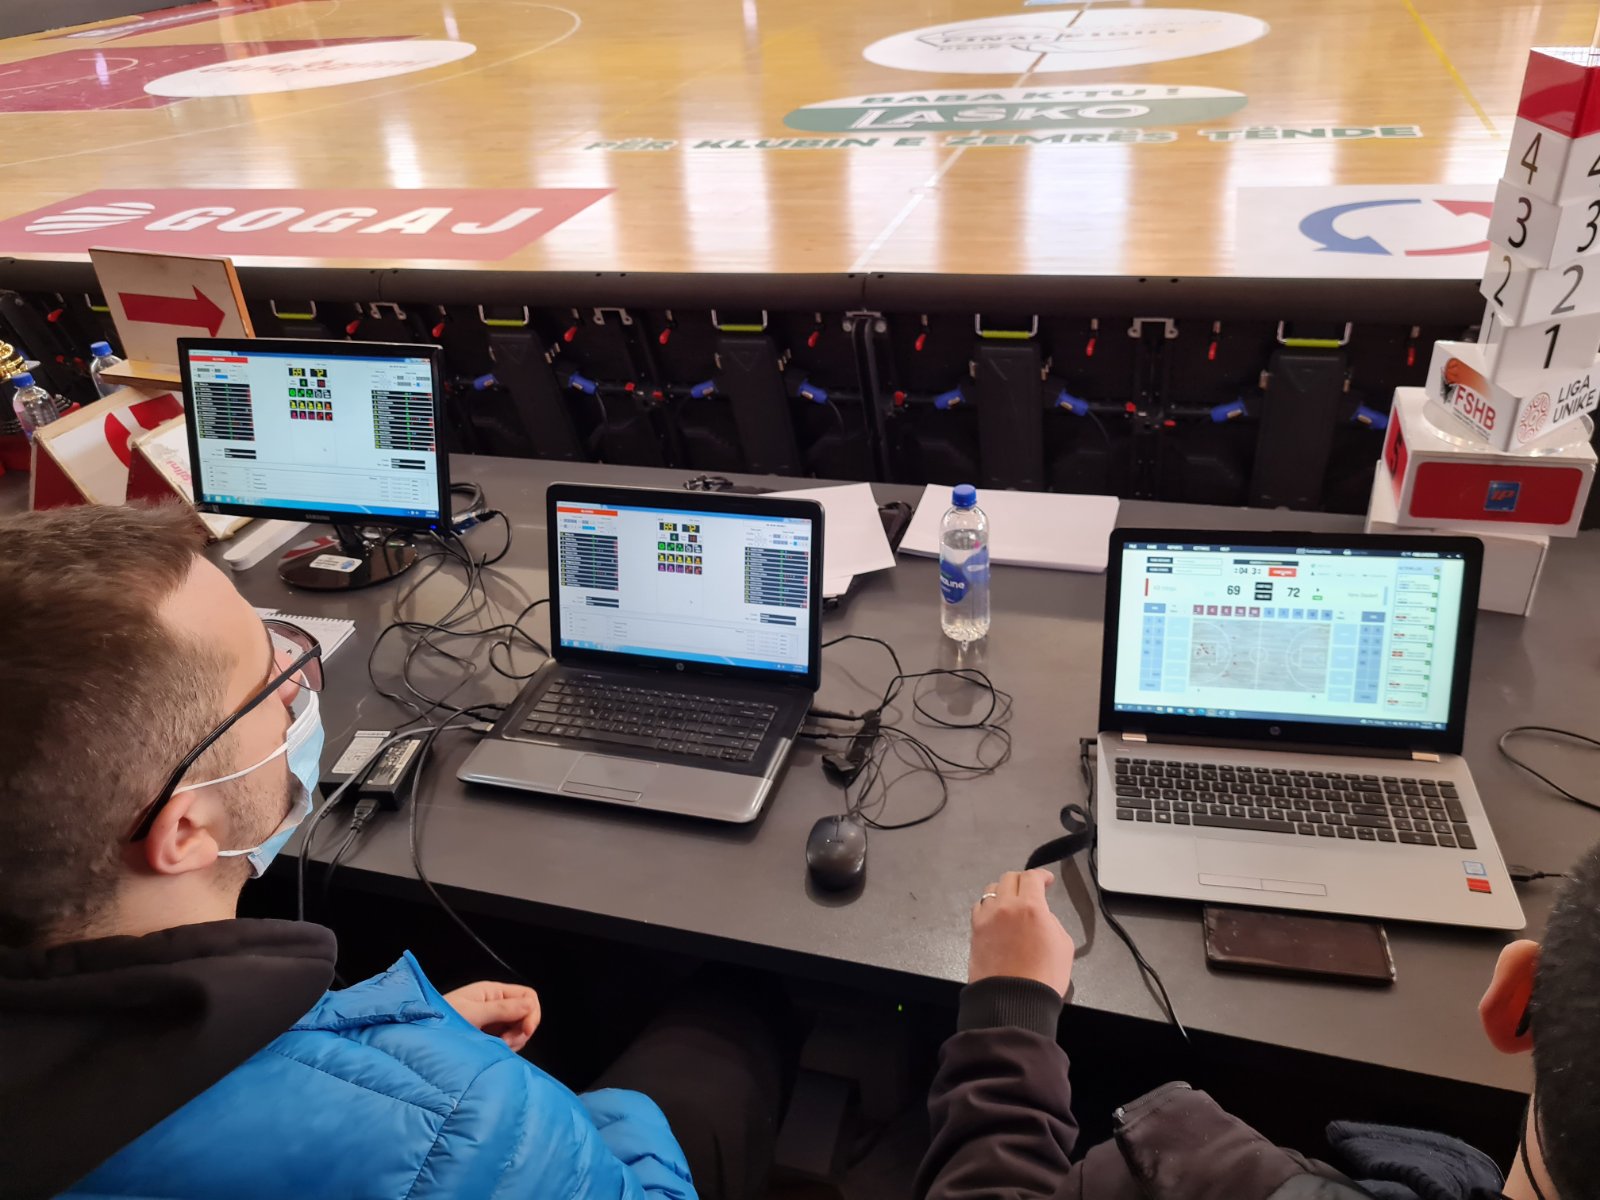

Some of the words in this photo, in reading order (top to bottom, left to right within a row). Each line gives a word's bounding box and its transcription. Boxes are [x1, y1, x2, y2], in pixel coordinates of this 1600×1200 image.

[860, 93, 1005, 104] BABA
[692, 137, 880, 149] KLUBIN
[893, 137, 927, 146] E
[1203, 125, 1417, 141] TËNDE
[1520, 131, 1542, 185] 4
[144, 207, 543, 235] GOGAJ
[1507, 197, 1532, 248] 3
[1576, 199, 1600, 253] 3
[1493, 255, 1512, 307] 2
[1550, 264, 1584, 315] 2
[1543, 323, 1561, 369] 1
[1454, 384, 1497, 431] FSHB
[1552, 389, 1597, 424] UNIKE
[1557, 374, 1590, 404] LIGA
[1226, 585, 1241, 595] 69
[1287, 587, 1300, 598] 72
